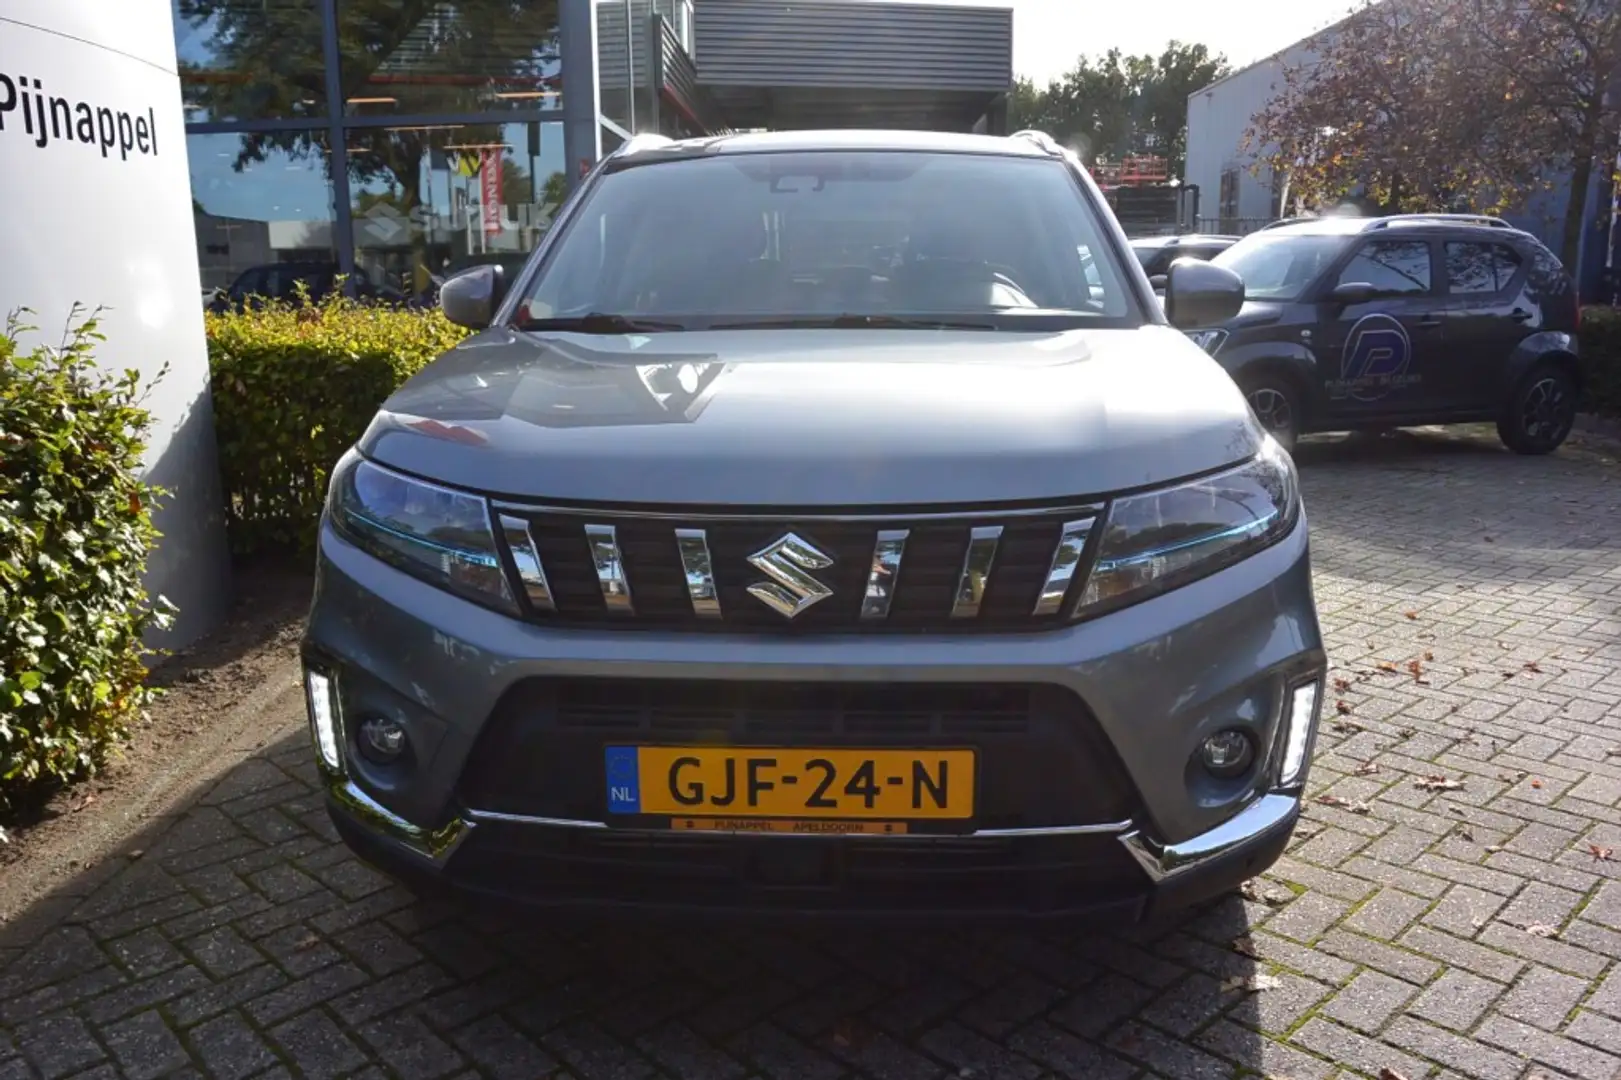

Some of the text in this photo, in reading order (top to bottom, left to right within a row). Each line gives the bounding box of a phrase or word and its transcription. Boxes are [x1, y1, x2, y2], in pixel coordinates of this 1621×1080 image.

[0, 73, 158, 161] Pijnappel
[410, 202, 560, 230] SUZUK
[610, 787, 636, 802] NL
[667, 756, 948, 809] GJF-24-N
